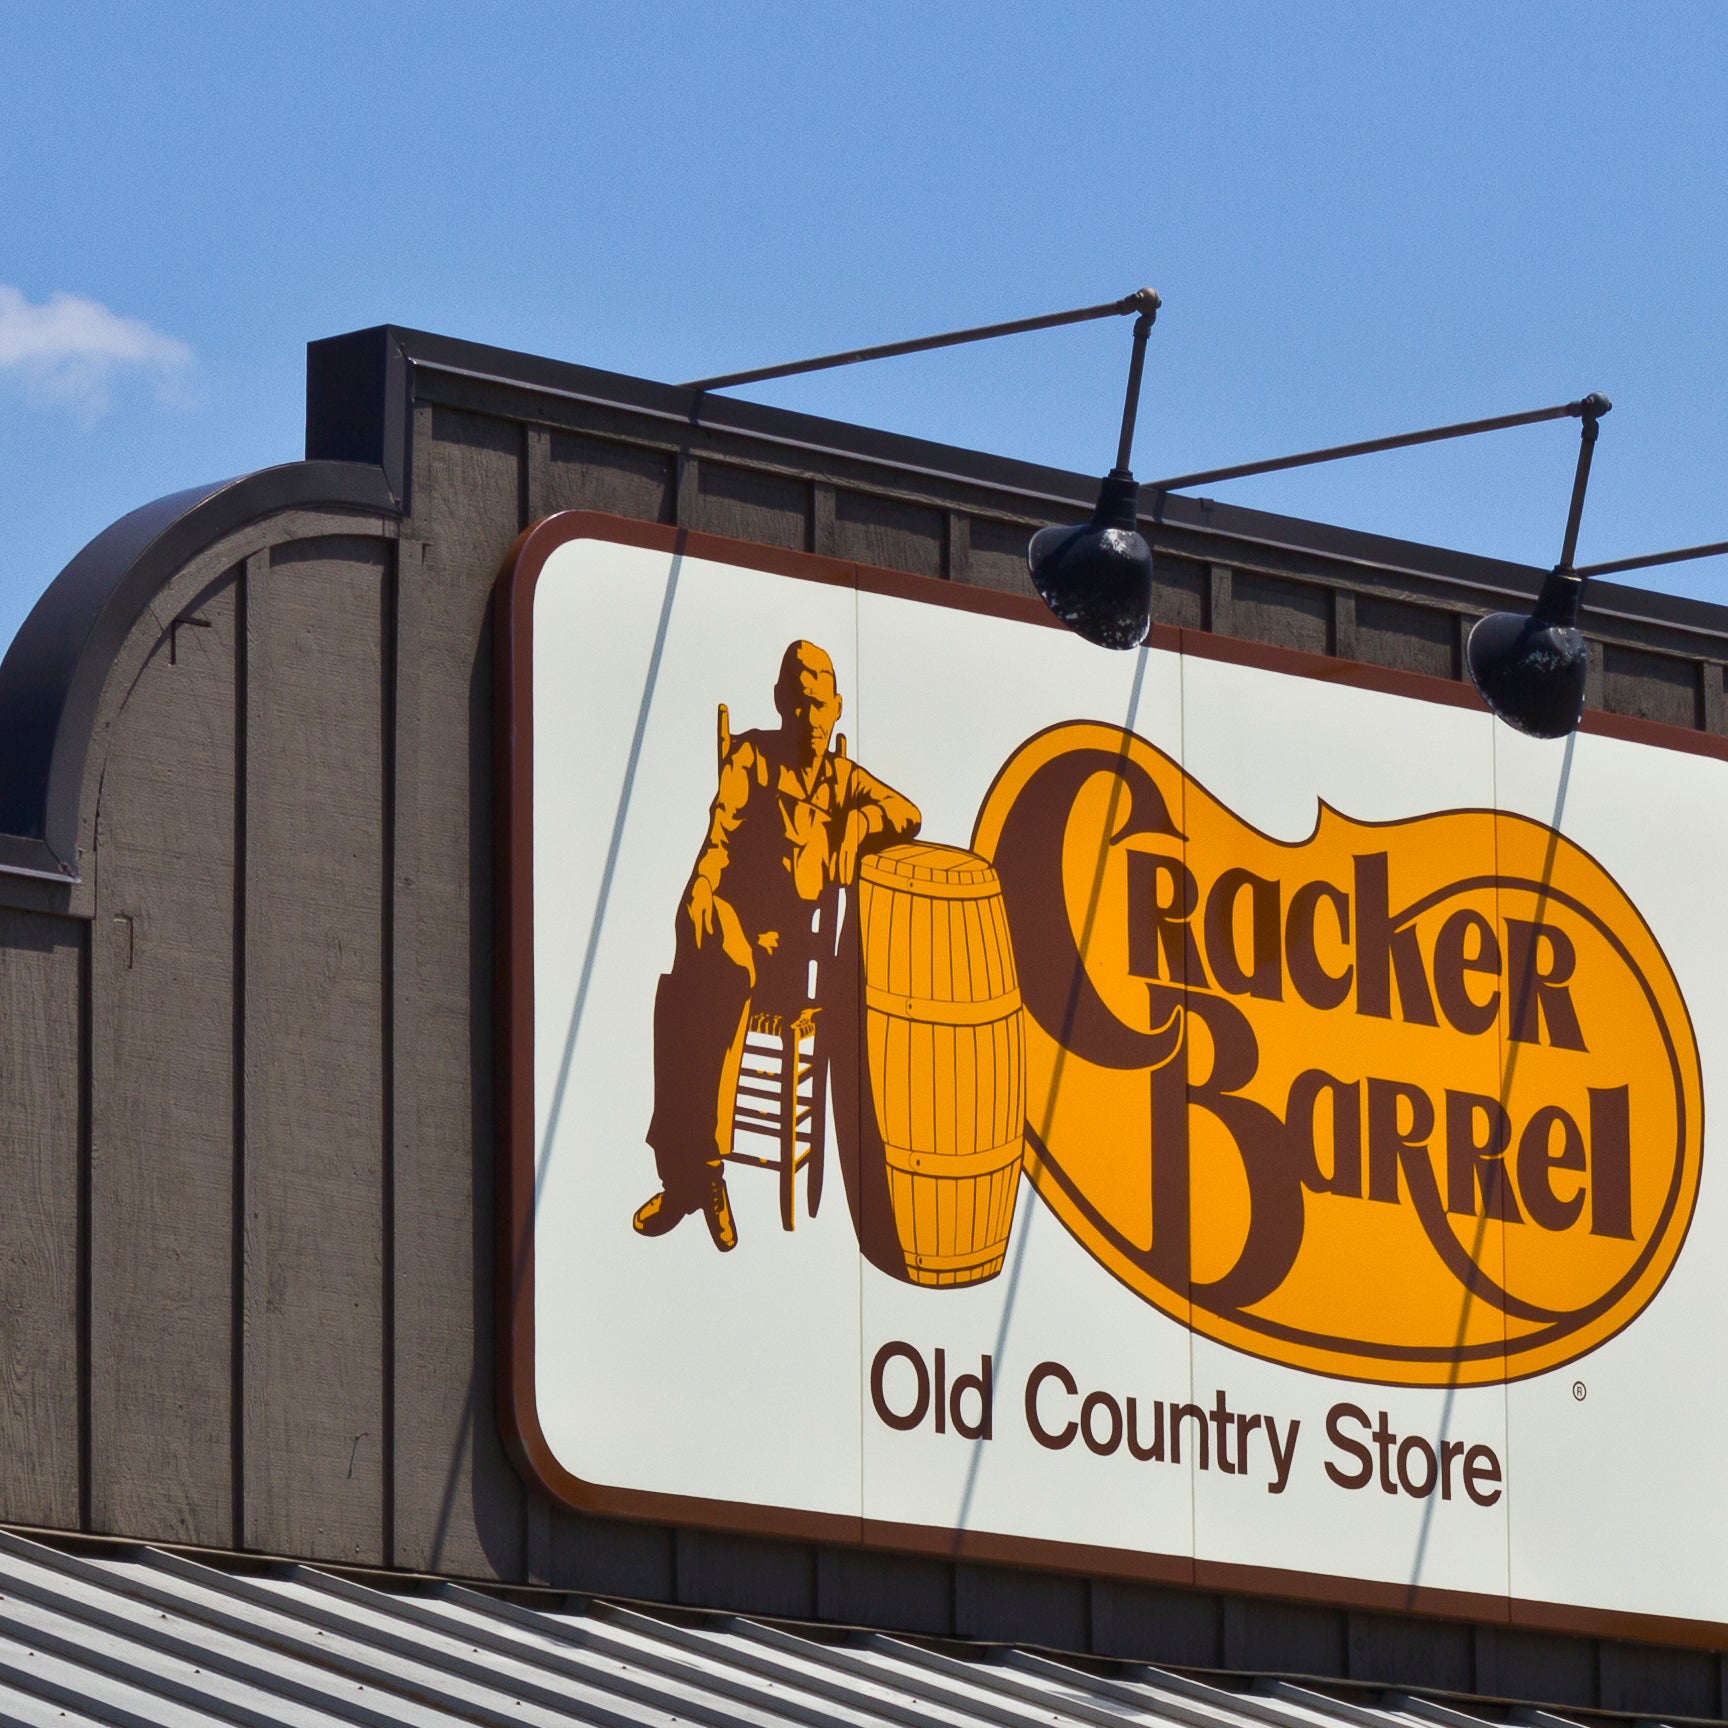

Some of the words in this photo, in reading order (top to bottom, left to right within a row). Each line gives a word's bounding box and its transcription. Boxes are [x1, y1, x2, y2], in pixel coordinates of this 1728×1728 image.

[991, 746, 1590, 1071] Cracker
[1146, 981, 1636, 1314] Barrel
[870, 1340, 994, 1441] Old
[1024, 1360, 1301, 1495] Country
[1323, 1402, 1503, 1508] Store
